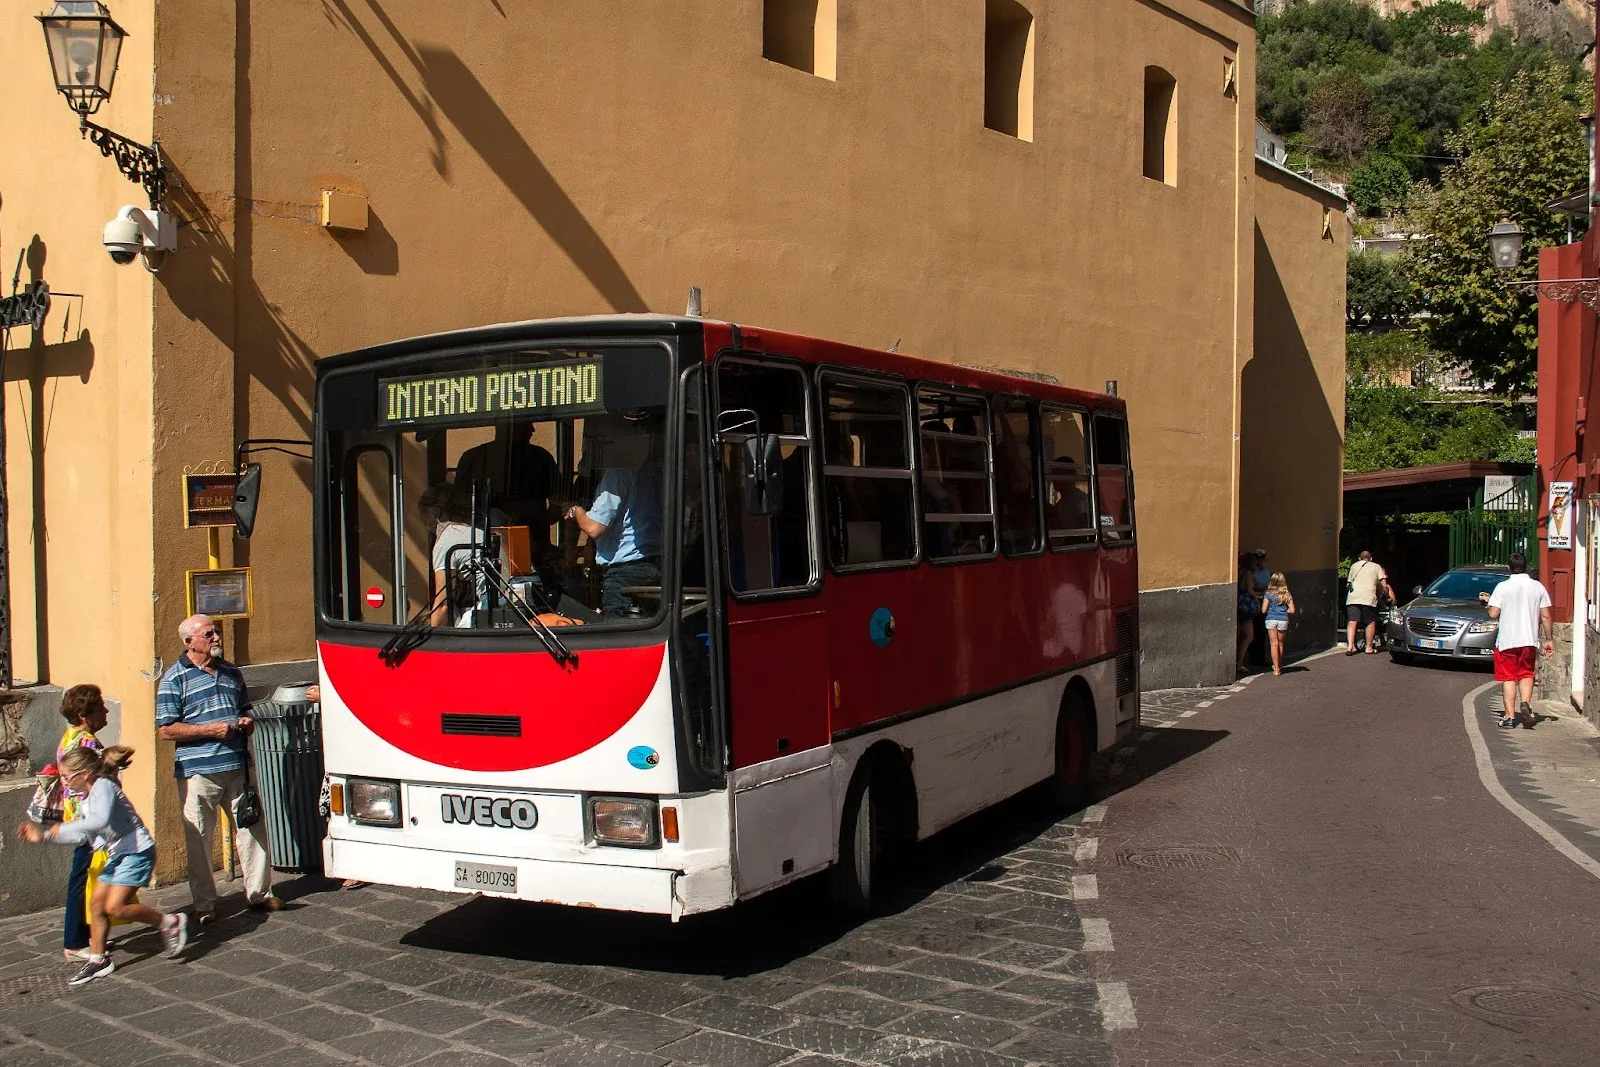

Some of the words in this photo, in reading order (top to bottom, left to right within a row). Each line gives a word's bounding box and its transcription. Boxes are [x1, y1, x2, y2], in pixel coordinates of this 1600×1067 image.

[387, 376, 478, 420] INTERNO
[486, 364, 597, 411] POSITANO
[193, 494, 233, 507] FERMA
[441, 794, 538, 830] IVECO
[475, 869, 516, 887] 800799
